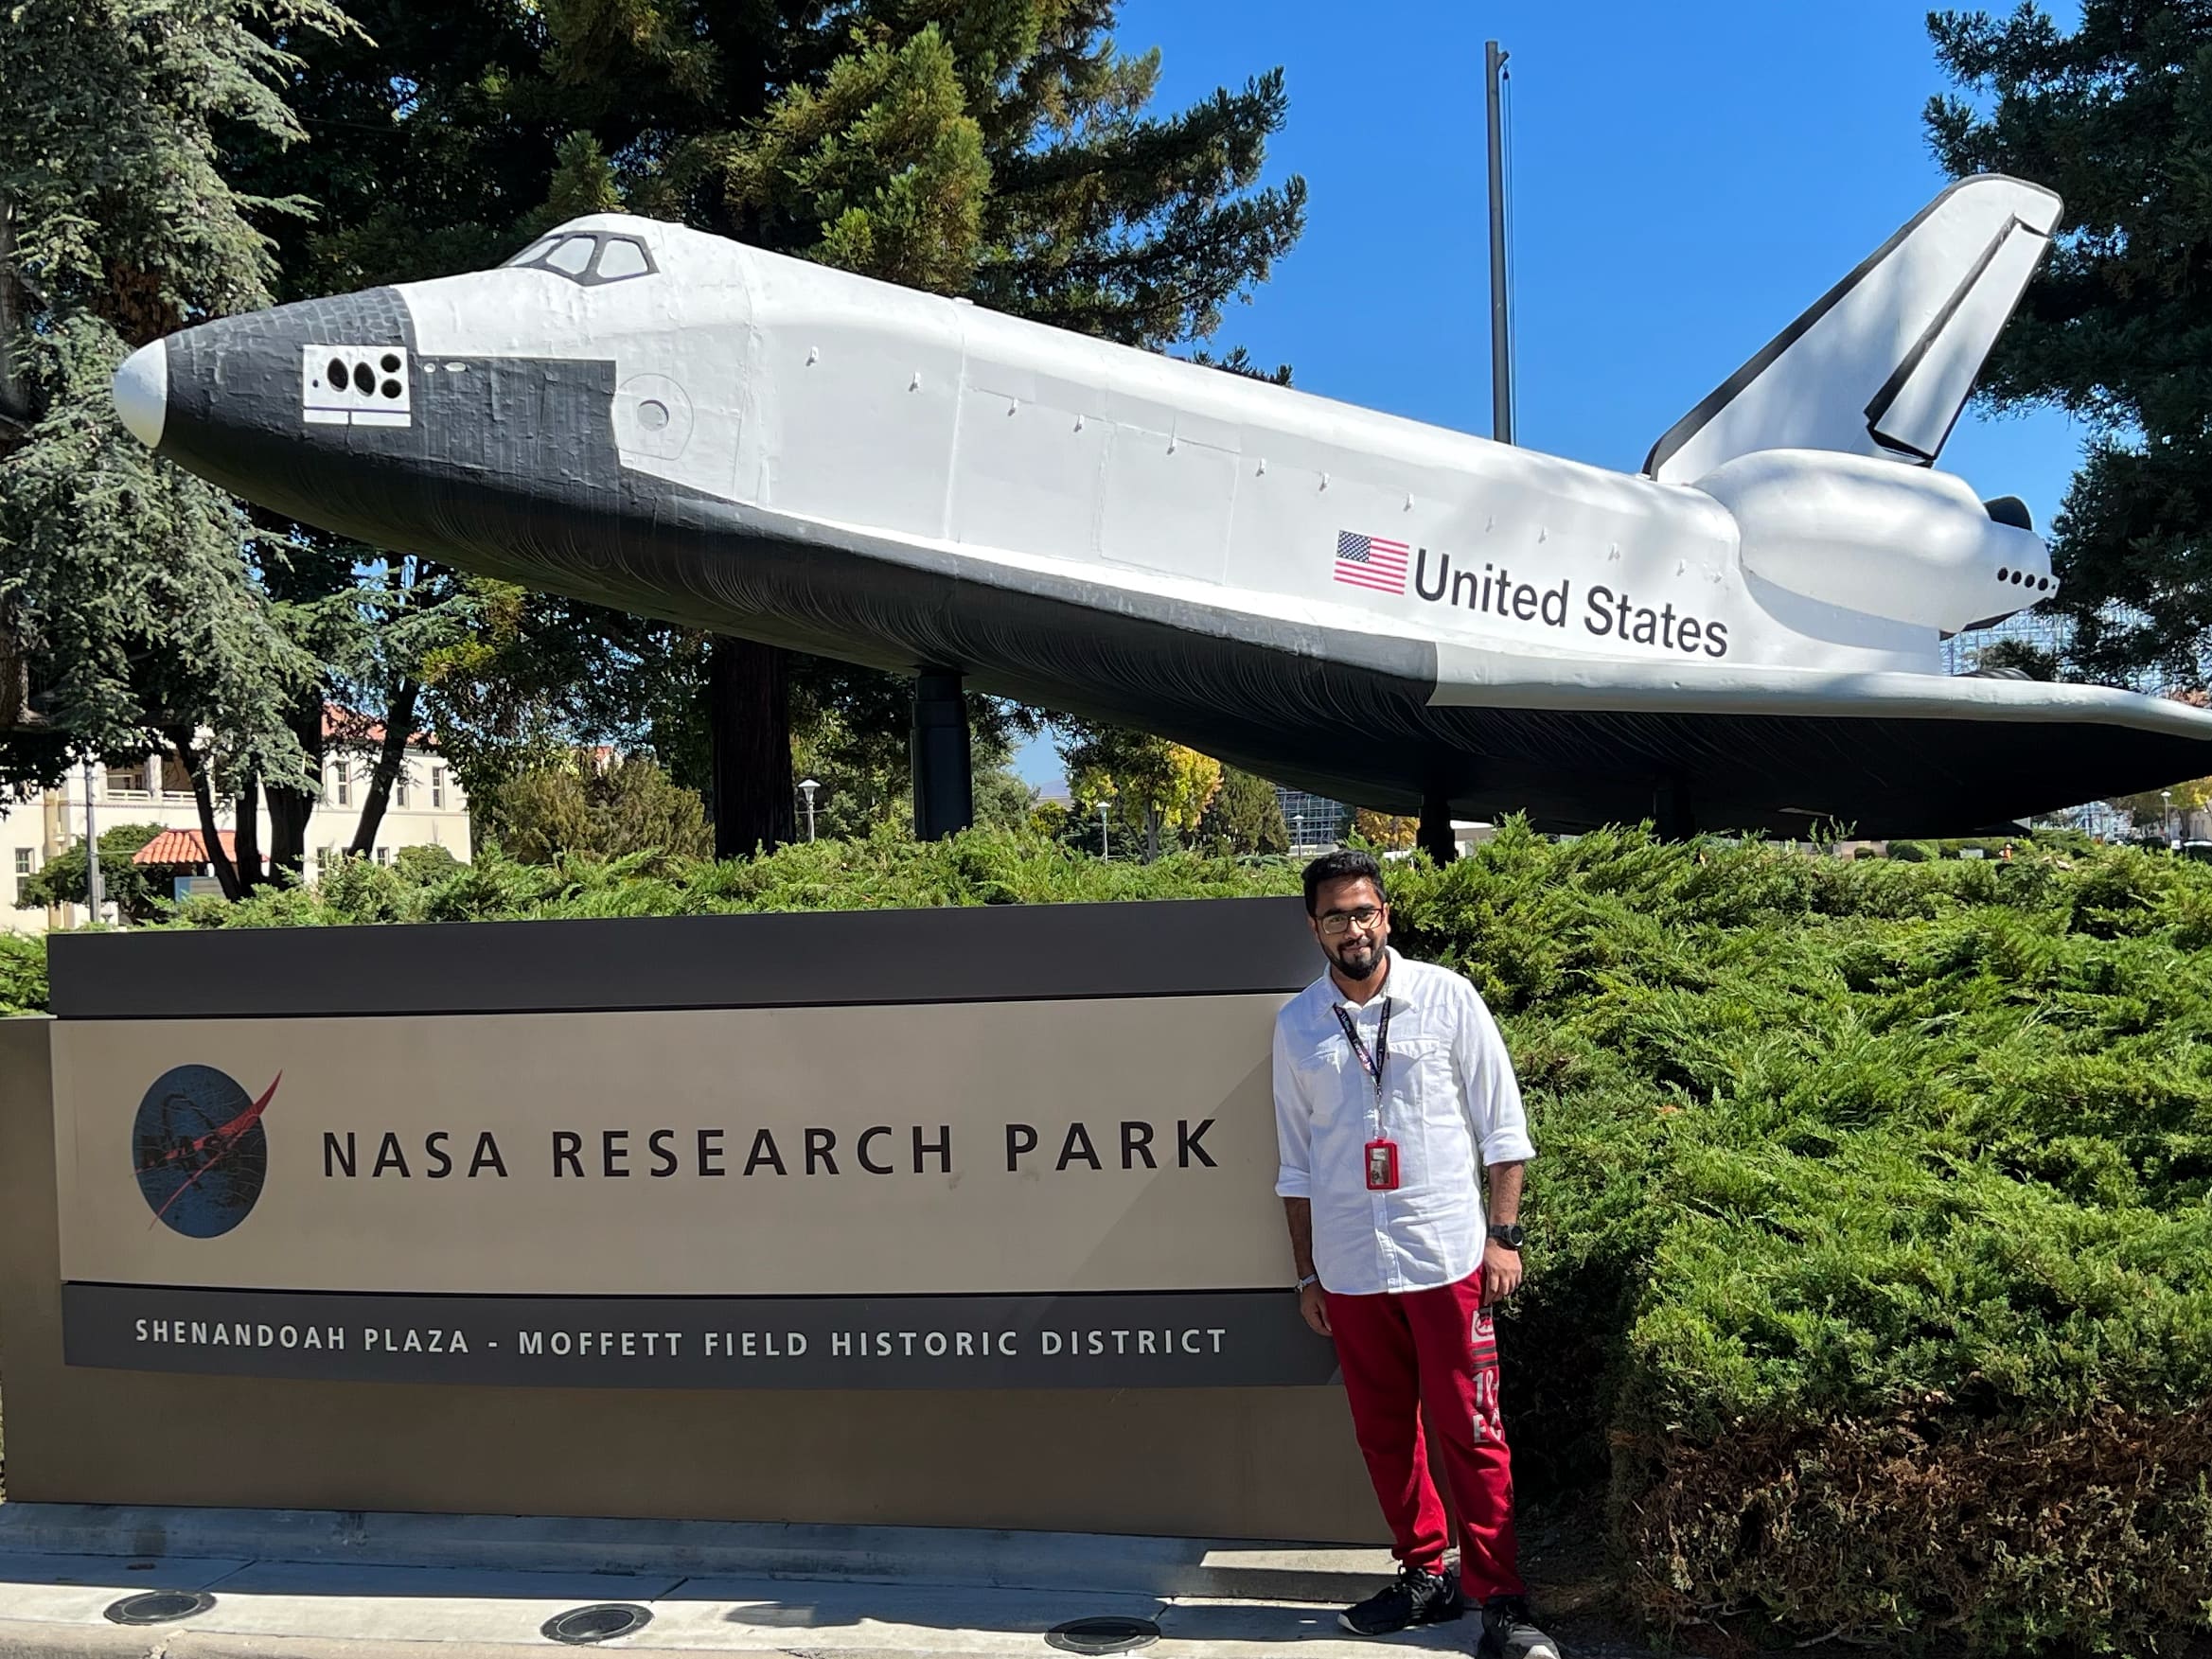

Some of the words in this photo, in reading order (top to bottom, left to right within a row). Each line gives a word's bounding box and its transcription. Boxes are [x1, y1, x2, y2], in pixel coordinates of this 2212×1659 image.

[1415, 548, 1569, 627] United
[1584, 586, 1727, 658] States
[324, 1132, 508, 1179] NASA
[553, 1125, 951, 1178] RESEARCH
[1006, 1119, 1218, 1173] PARK
[136, 1319, 345, 1350] SHENANDOAH
[364, 1329, 469, 1353] PLAZA
[519, 1332, 682, 1356] MOFFETT
[705, 1332, 806, 1356] FIELD
[832, 1332, 1017, 1356] HISTORIC
[1042, 1329, 1226, 1354] DISTRICT
